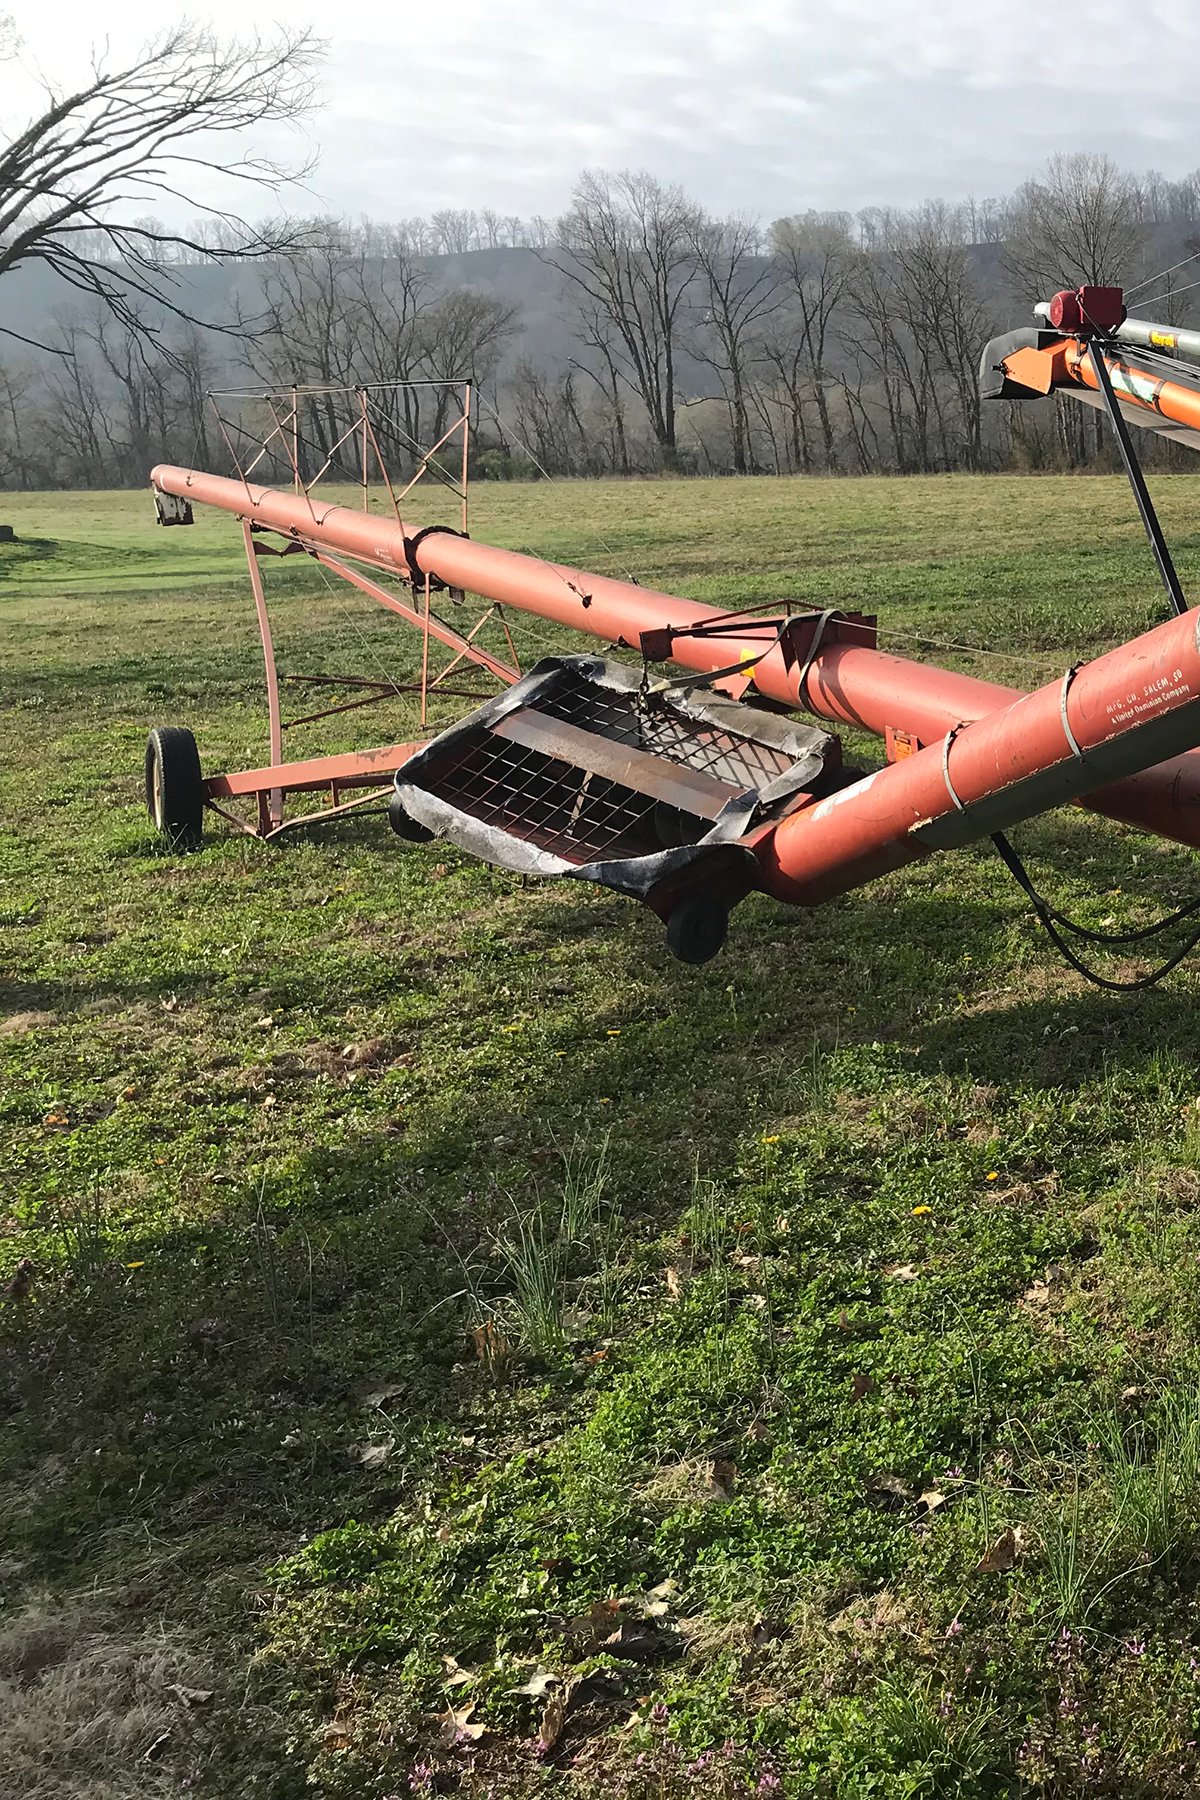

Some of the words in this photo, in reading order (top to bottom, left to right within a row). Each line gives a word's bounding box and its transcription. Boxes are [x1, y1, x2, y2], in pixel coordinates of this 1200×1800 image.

[1143, 677, 1173, 696] SALEM,
[1173, 669, 1183, 682] SD
[1115, 708, 1134, 721] United
[1134, 697, 1163, 714] Dominion
[1161, 684, 1190, 701] Company
